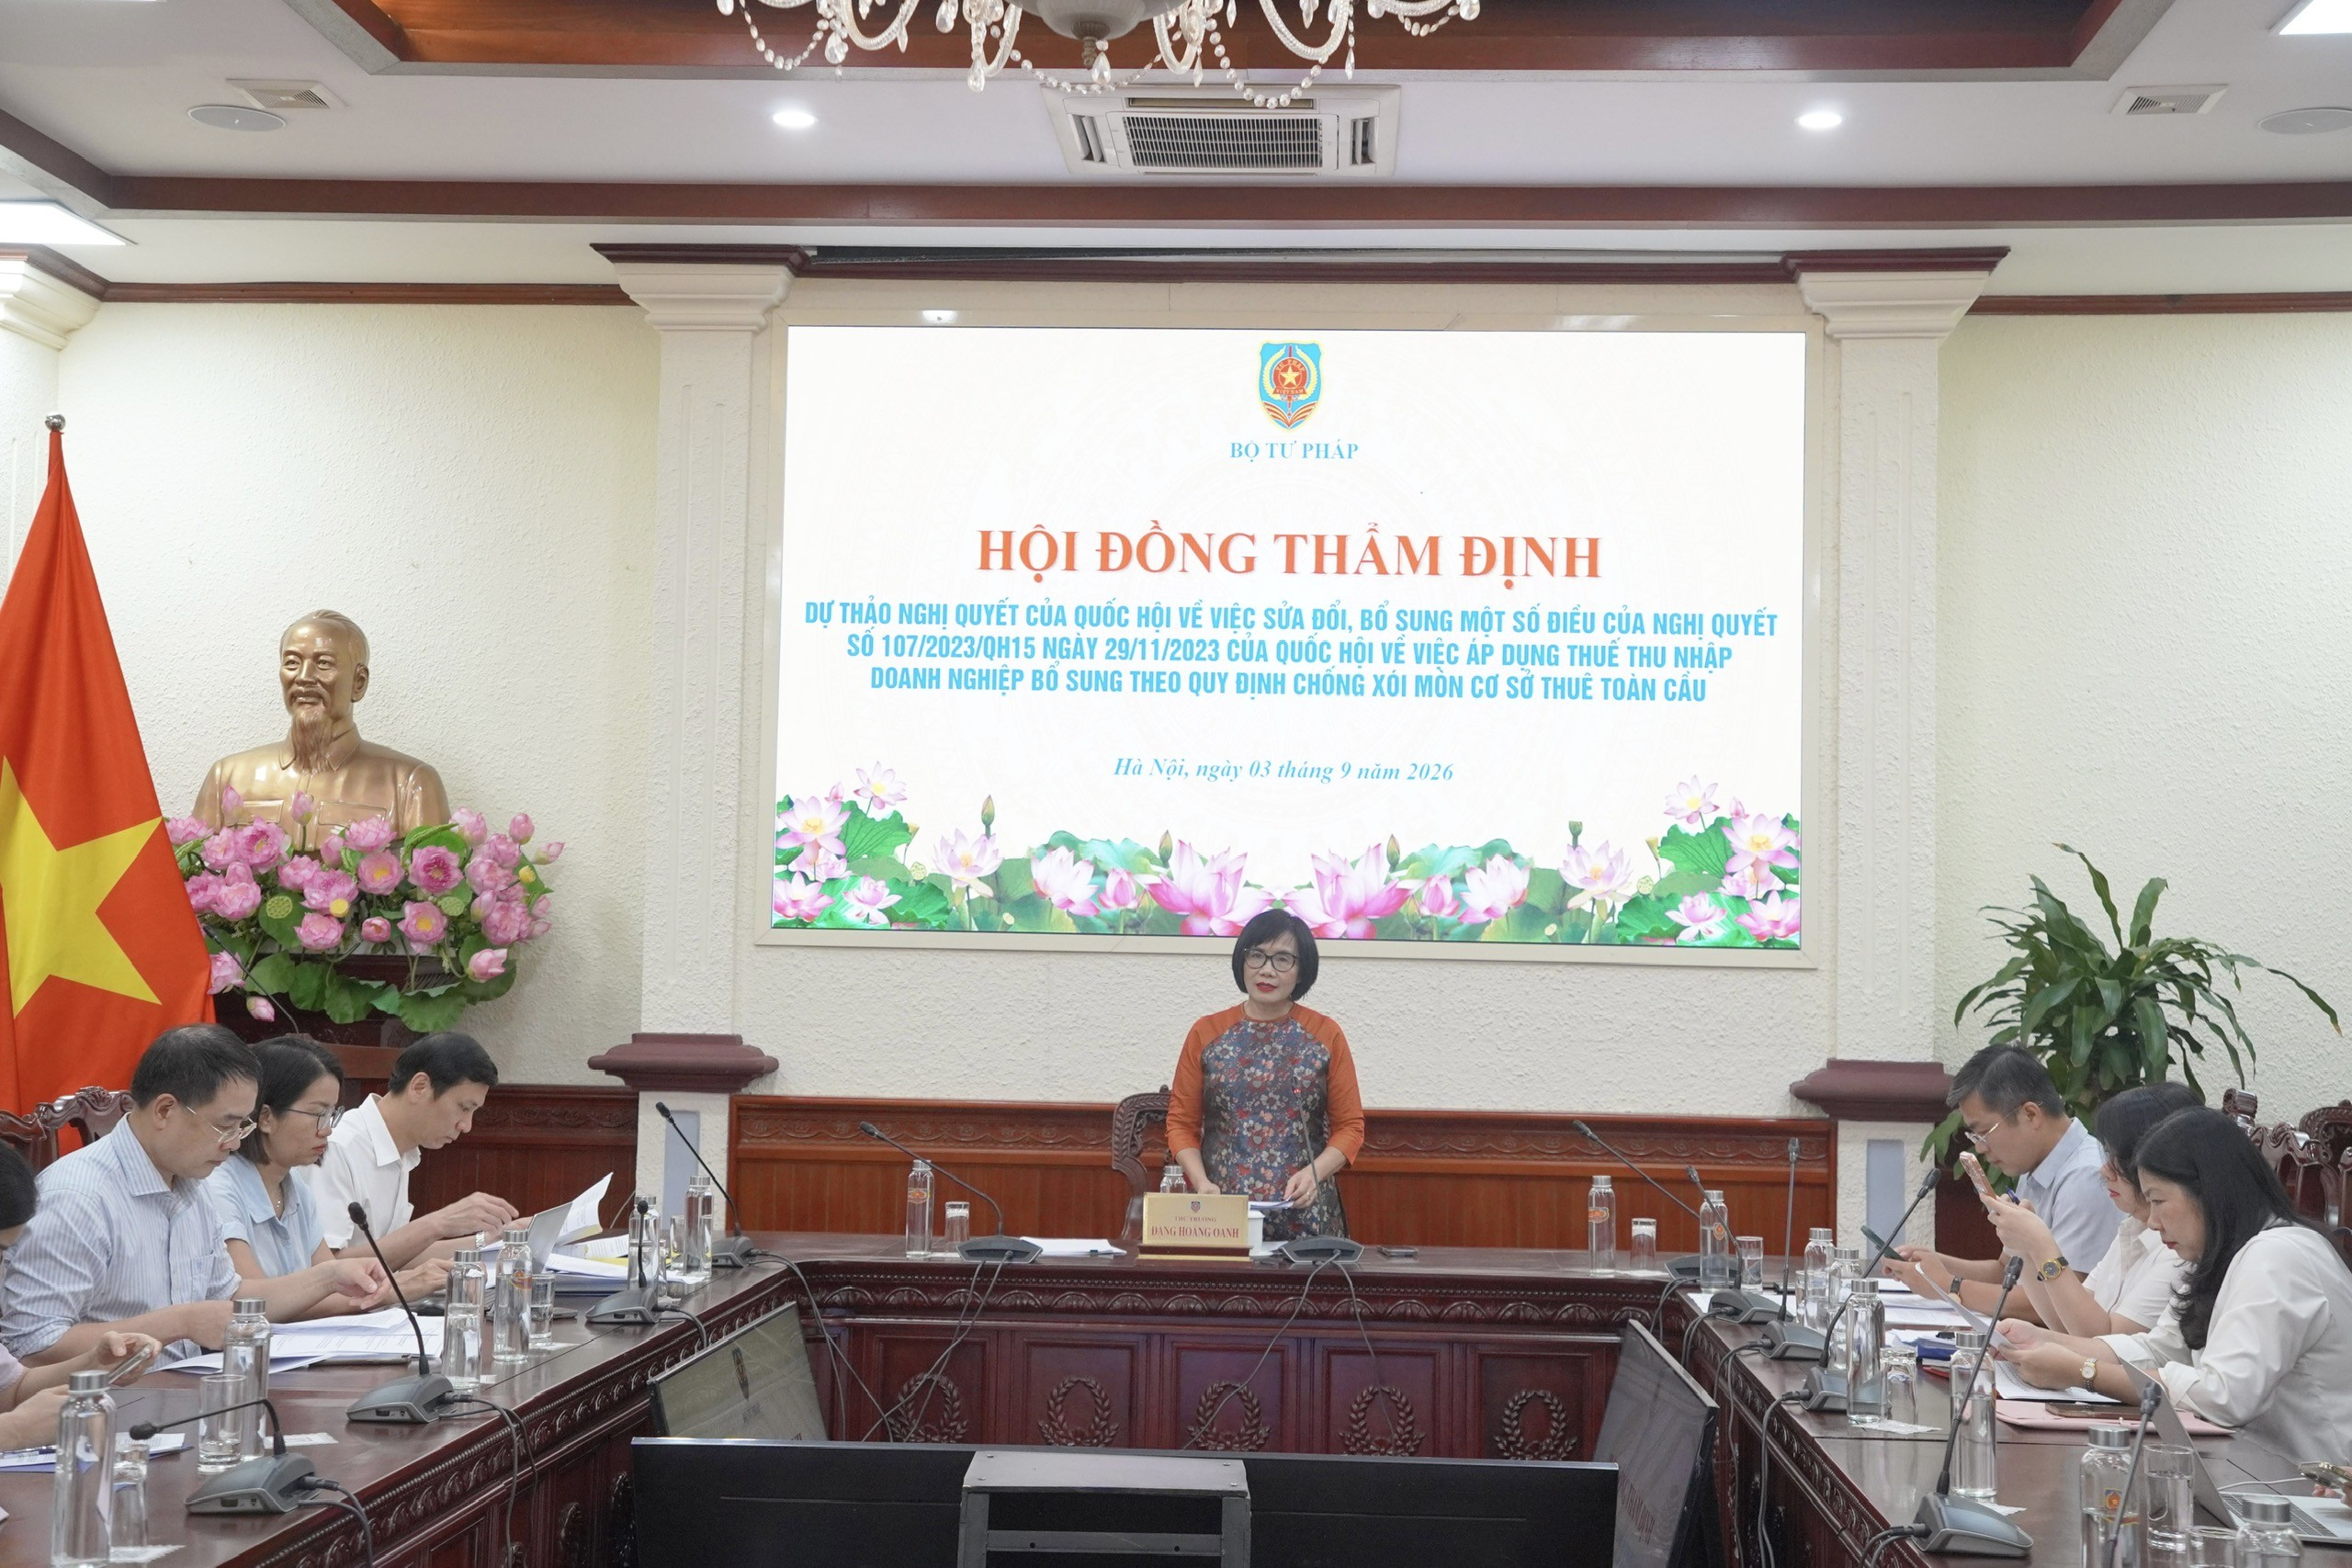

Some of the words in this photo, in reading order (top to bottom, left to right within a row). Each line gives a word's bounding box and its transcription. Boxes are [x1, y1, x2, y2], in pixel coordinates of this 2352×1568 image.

[1230, 441, 1260, 462] BỘ
[1266, 441, 1297, 458] TƯ
[1303, 439, 1358, 459] PHÁP
[976, 525, 1080, 583] HỘI
[1095, 520, 1258, 574] ĐỒNG
[1273, 523, 1442, 576] THẨM
[1459, 536, 1602, 590] ĐỊNH
[806, 600, 835, 628] DỰ
[840, 595, 891, 624] THẢO
[899, 603, 948, 630] NGHỊ
[956, 597, 1019, 627] QUYẾT
[1026, 598, 1067, 626] CỦA
[1074, 598, 1129, 629] QUỐC
[1137, 603, 1171, 633] HỘI
[1179, 600, 1203, 628] VỀ
[1210, 603, 1255, 634] VIỆC
[1263, 601, 1305, 630] SỬA
[1312, 600, 1352, 634] ĐỔI,
[1361, 600, 1387, 631] BỔ
[1396, 609, 1453, 632] SUNG
[1461, 606, 1506, 637] MỘT
[1513, 604, 1540, 633] SỐ
[1547, 604, 1595, 634] ĐIỀU
[1603, 605, 1645, 635] CỦA
[1654, 613, 1703, 640] NGHỊ
[1712, 609, 1778, 637] QUYẾT
[847, 626, 874, 657] SỐ
[883, 635, 1035, 660] 107/2023/QH15
[1043, 633, 1097, 660] NGÀY
[1105, 637, 1220, 661] 29/11/2023
[1227, 631, 1268, 662] CỦA
[1276, 632, 1331, 664] QUỐC
[1340, 637, 1374, 669] HỘI
[1381, 635, 1406, 664] VỀ
[1413, 637, 1459, 671] VIỆC
[1466, 637, 1494, 665] ÁP
[1502, 644, 1559, 672] DỤNG
[1566, 637, 1619, 667] THUẾ
[1627, 646, 1667, 668] THU
[1674, 642, 1733, 674] NHẬP
[871, 667, 941, 689] DOANH
[948, 664, 1024, 696] NGHIỆP
[1031, 660, 1058, 691] BỔ
[1066, 670, 1123, 692] SUNG
[1130, 671, 1182, 693] THEO
[1189, 671, 1228, 696] QUY
[1236, 672, 1285, 700] ĐỊNH
[1294, 666, 1365, 696] CHỐNG
[1373, 670, 1407, 697] XÓI
[1415, 670, 1463, 698] MÒN
[1471, 674, 1499, 698] CƠ
[1506, 668, 1534, 699] SỞ
[1600, 673, 1657, 701] TOÀN
[1664, 671, 1706, 702] CẦU
[1114, 758, 1143, 777] Hà
[1149, 759, 1189, 781] Nội,
[1196, 760, 1242, 782] ngày
[1250, 761, 1272, 778] 03
[1278, 761, 1334, 784] tháng
[1340, 761, 1352, 779] 9
[1358, 763, 1400, 781] năm
[1407, 762, 1453, 781] 2026
[1214, 1227, 1239, 1238] OANH
